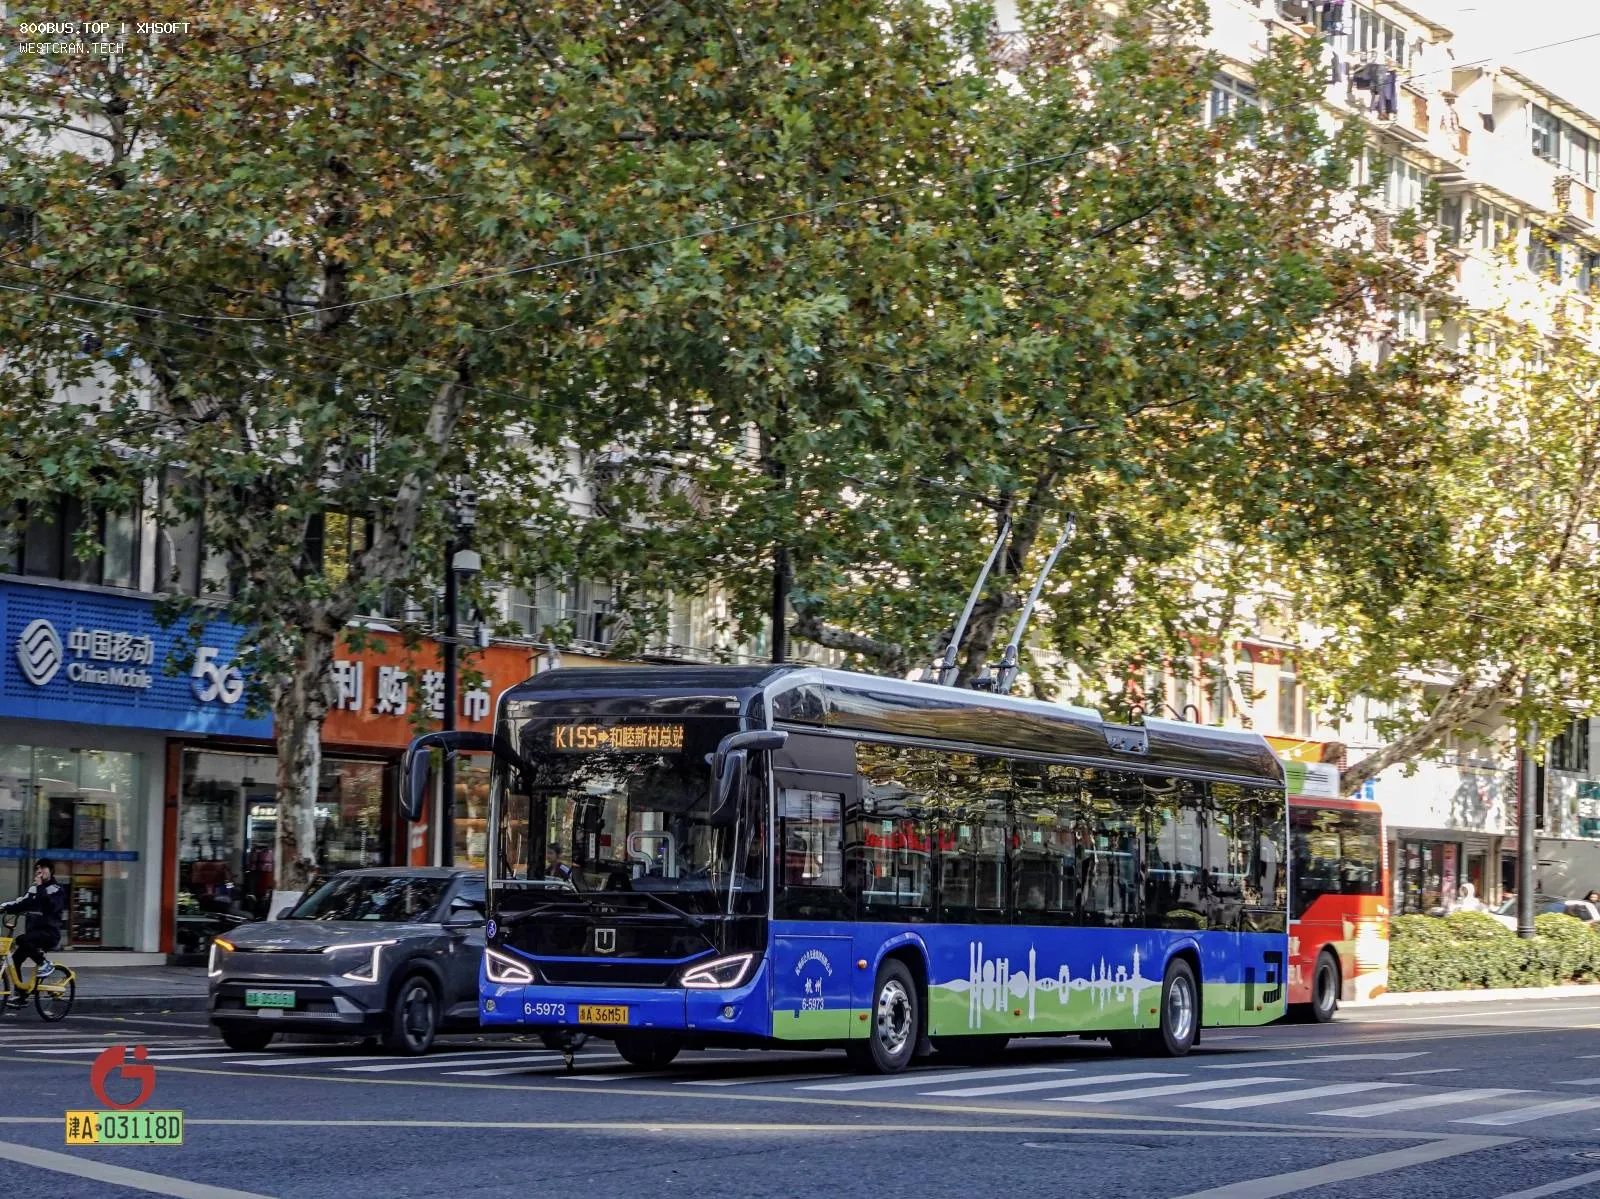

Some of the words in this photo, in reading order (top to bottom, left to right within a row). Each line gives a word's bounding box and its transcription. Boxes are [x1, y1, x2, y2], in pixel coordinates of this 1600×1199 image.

[67, 627, 154, 665] 中国移动
[66, 662, 108, 685] China
[108, 667, 152, 689] Mobile
[191, 646, 244, 704] 5G
[524, 1002, 566, 1016] 6-5973
[802, 997, 824, 1011] 6-5973
